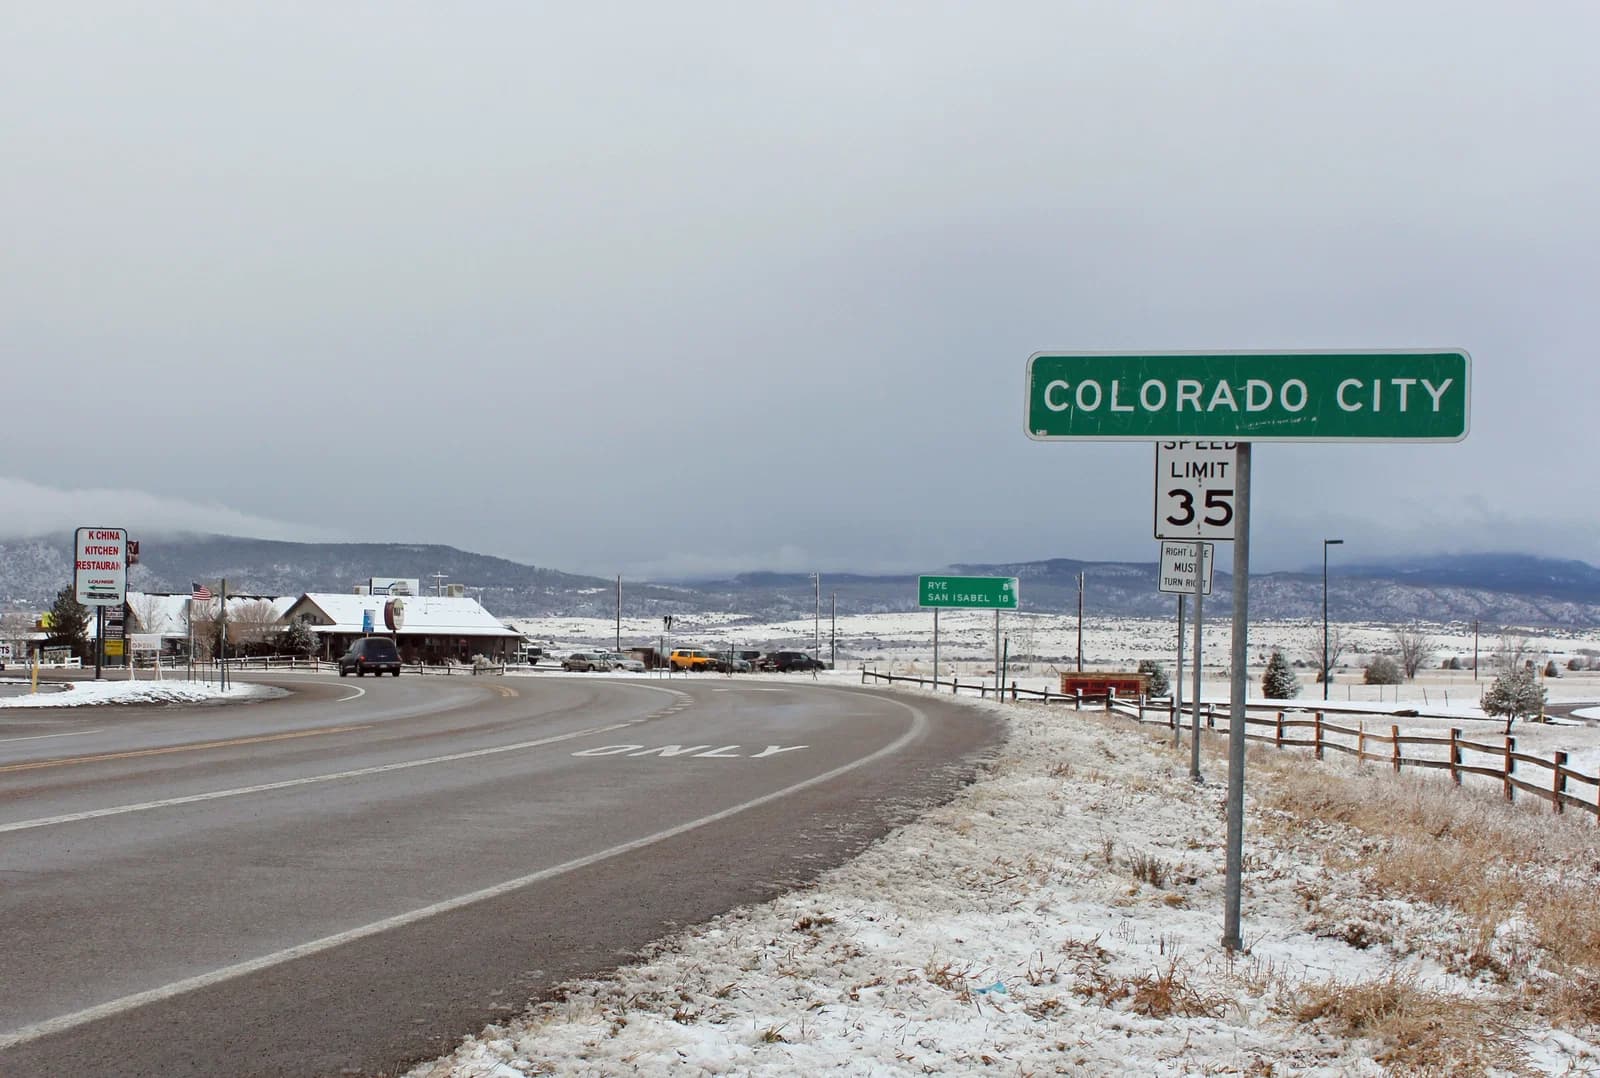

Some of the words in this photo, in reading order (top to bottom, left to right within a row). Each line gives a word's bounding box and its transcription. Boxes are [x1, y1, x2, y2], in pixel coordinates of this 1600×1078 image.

[1044, 379, 1308, 412] COLORADO
[1336, 378, 1454, 412] CITY
[1171, 461, 1229, 478] LIMIT
[1166, 488, 1234, 527] 35
[88, 531, 94, 540] K
[96, 531, 120, 540] CHINA
[85, 546, 119, 555] KITCHEN
[1165, 548, 1187, 556] RIGHT
[1190, 549, 1209, 558] LE
[928, 581, 948, 590] RYE
[1164, 577, 1183, 587] TURN
[928, 593, 949, 601] SAN
[953, 594, 990, 602] ISABEL
[571, 745, 808, 758] ONLY
